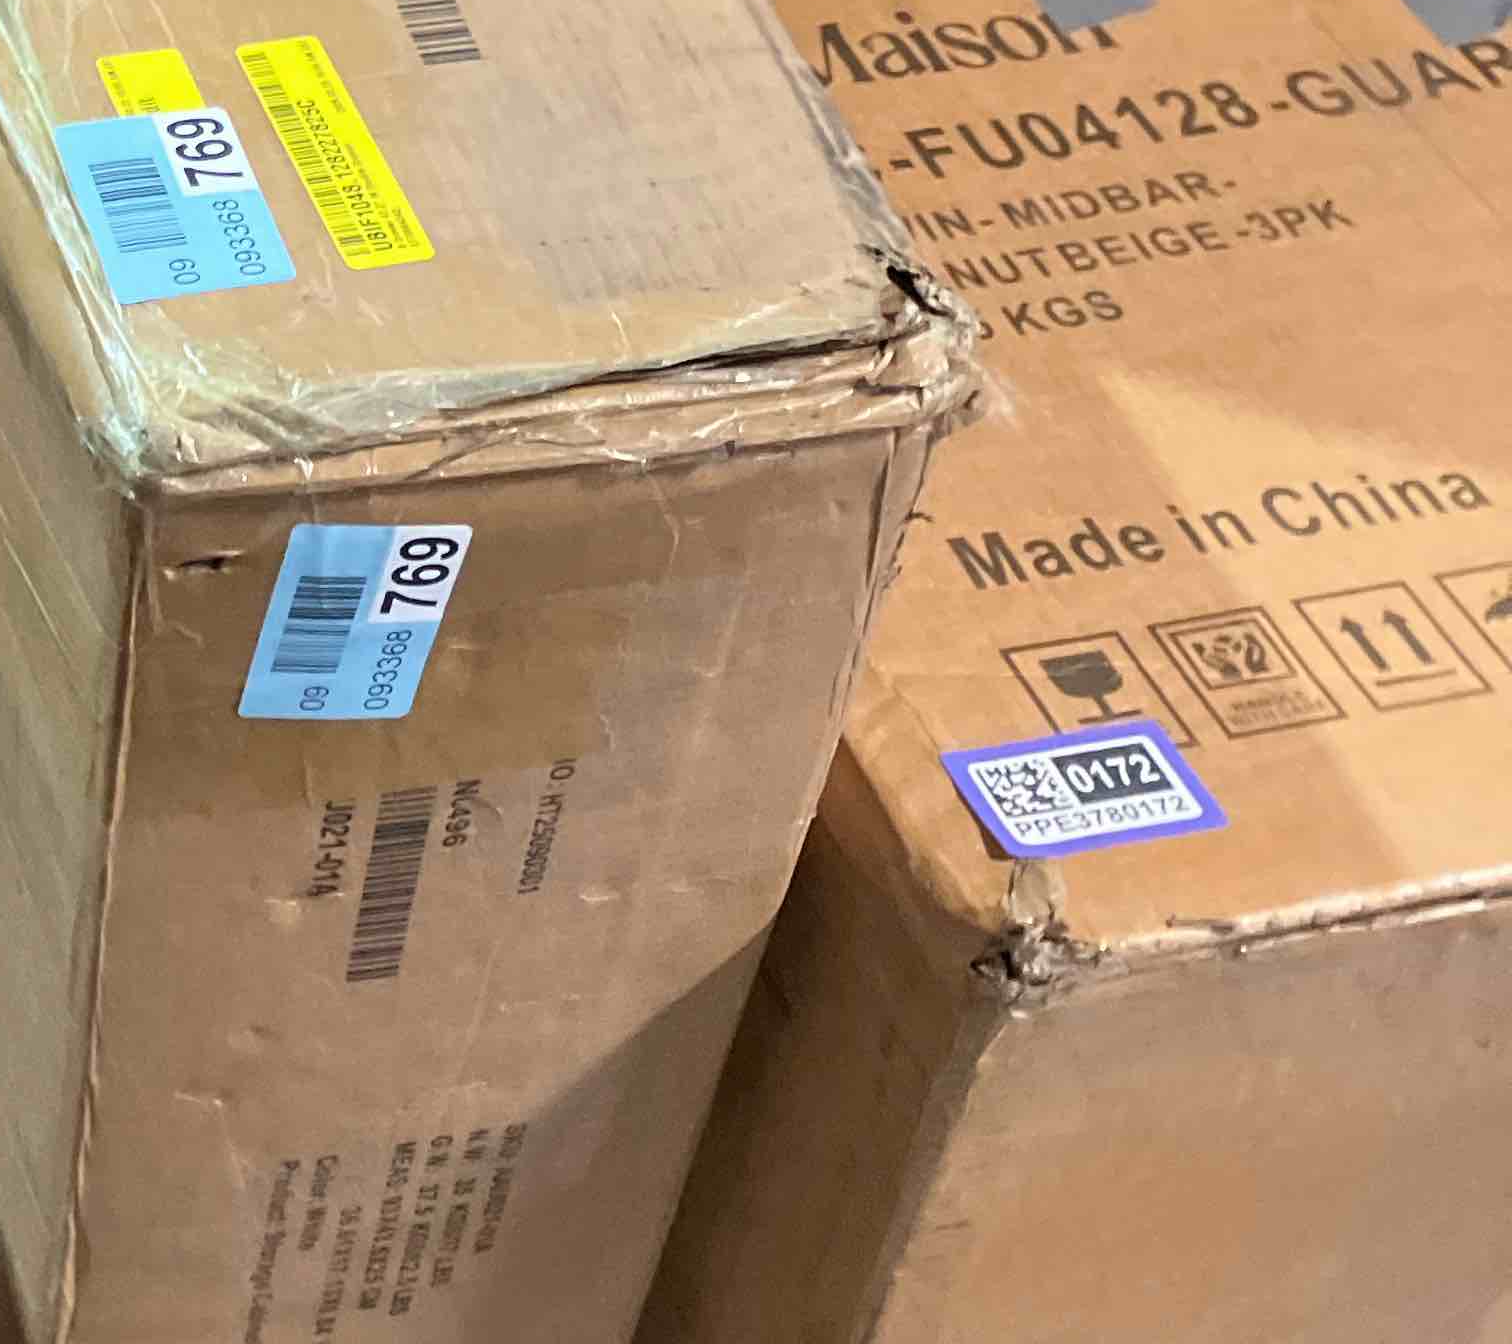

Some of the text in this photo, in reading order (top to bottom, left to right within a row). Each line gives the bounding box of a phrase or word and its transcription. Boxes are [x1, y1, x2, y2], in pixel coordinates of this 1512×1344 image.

[858, 40, 1512, 181] -FU04128-GUAR
[166, 116, 245, 189] 769
[212, 199, 266, 276] 093368
[903, 169, 1237, 244] IN-MIDBAR-
[169, 257, 201, 286] 09
[1007, 291, 1125, 343] KGS
[947, 467, 1494, 591] Made in China
[380, 536, 459, 616] 769
[299, 685, 331, 712] 09
[363, 629, 413, 712] 093368
[1066, 752, 1162, 794] 0172
[1013, 794, 1192, 838] PPE3780172
